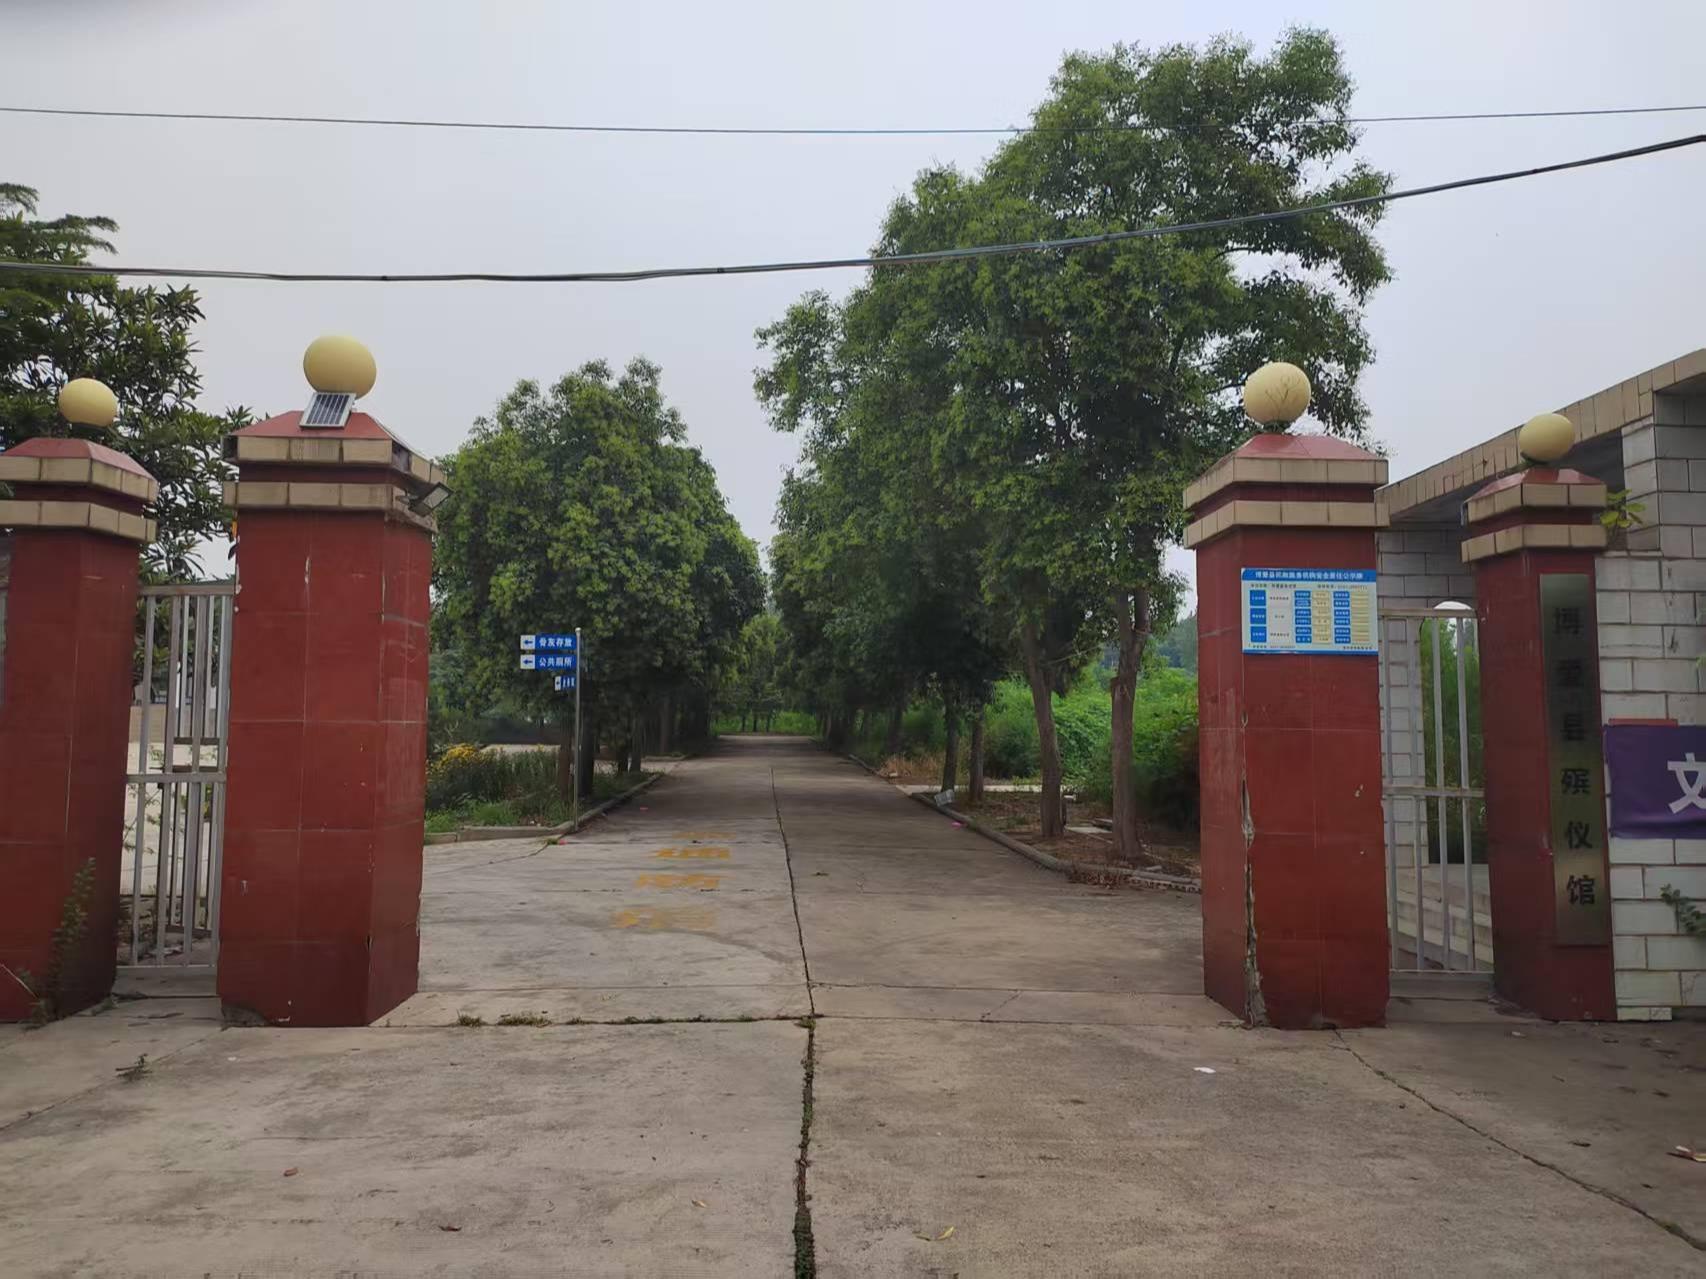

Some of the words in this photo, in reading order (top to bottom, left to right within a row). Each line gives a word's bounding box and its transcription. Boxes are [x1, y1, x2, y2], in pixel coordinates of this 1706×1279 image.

[539, 657, 572, 667] 公共厕所
[1667, 752, 1706, 814] 文
